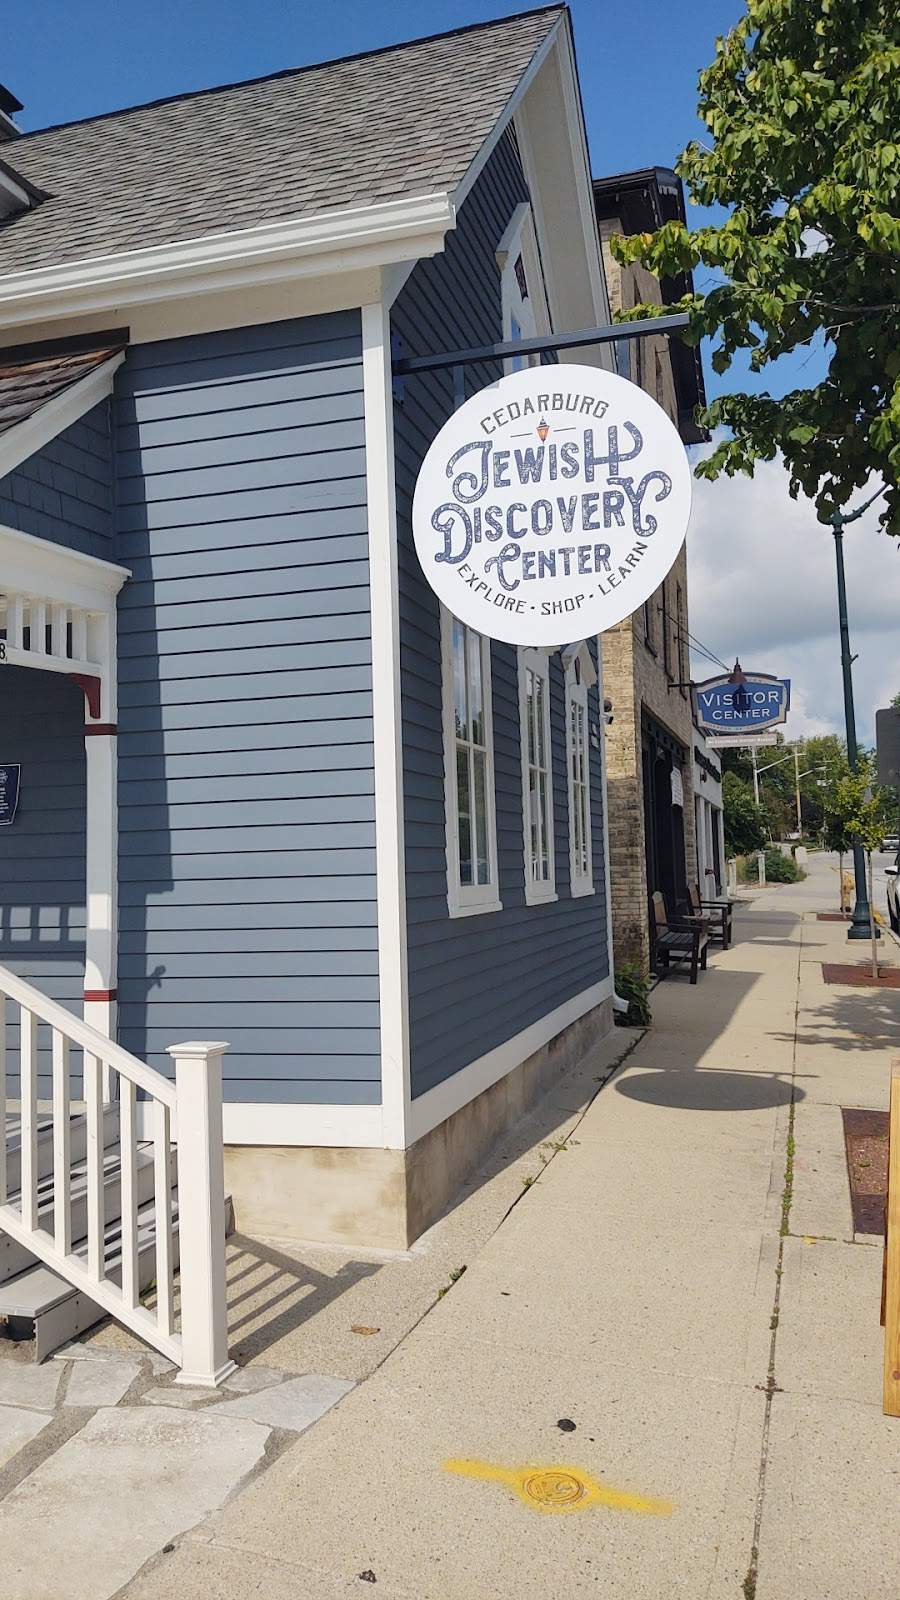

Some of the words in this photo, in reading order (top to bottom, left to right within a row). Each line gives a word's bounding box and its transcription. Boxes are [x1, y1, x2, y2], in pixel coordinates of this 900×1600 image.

[480, 393, 609, 435] CEDARBURG
[446, 421, 643, 504] JEWISH
[431, 470, 672, 564] DISCOVERY
[457, 563, 526, 614] EXPLORE
[541, 594, 585, 615] SHOP
[598, 541, 649, 596] LEARN
[484, 543, 611, 591] CENTER
[702, 691, 779, 707] VISITOR
[712, 708, 770, 720] CENTER
